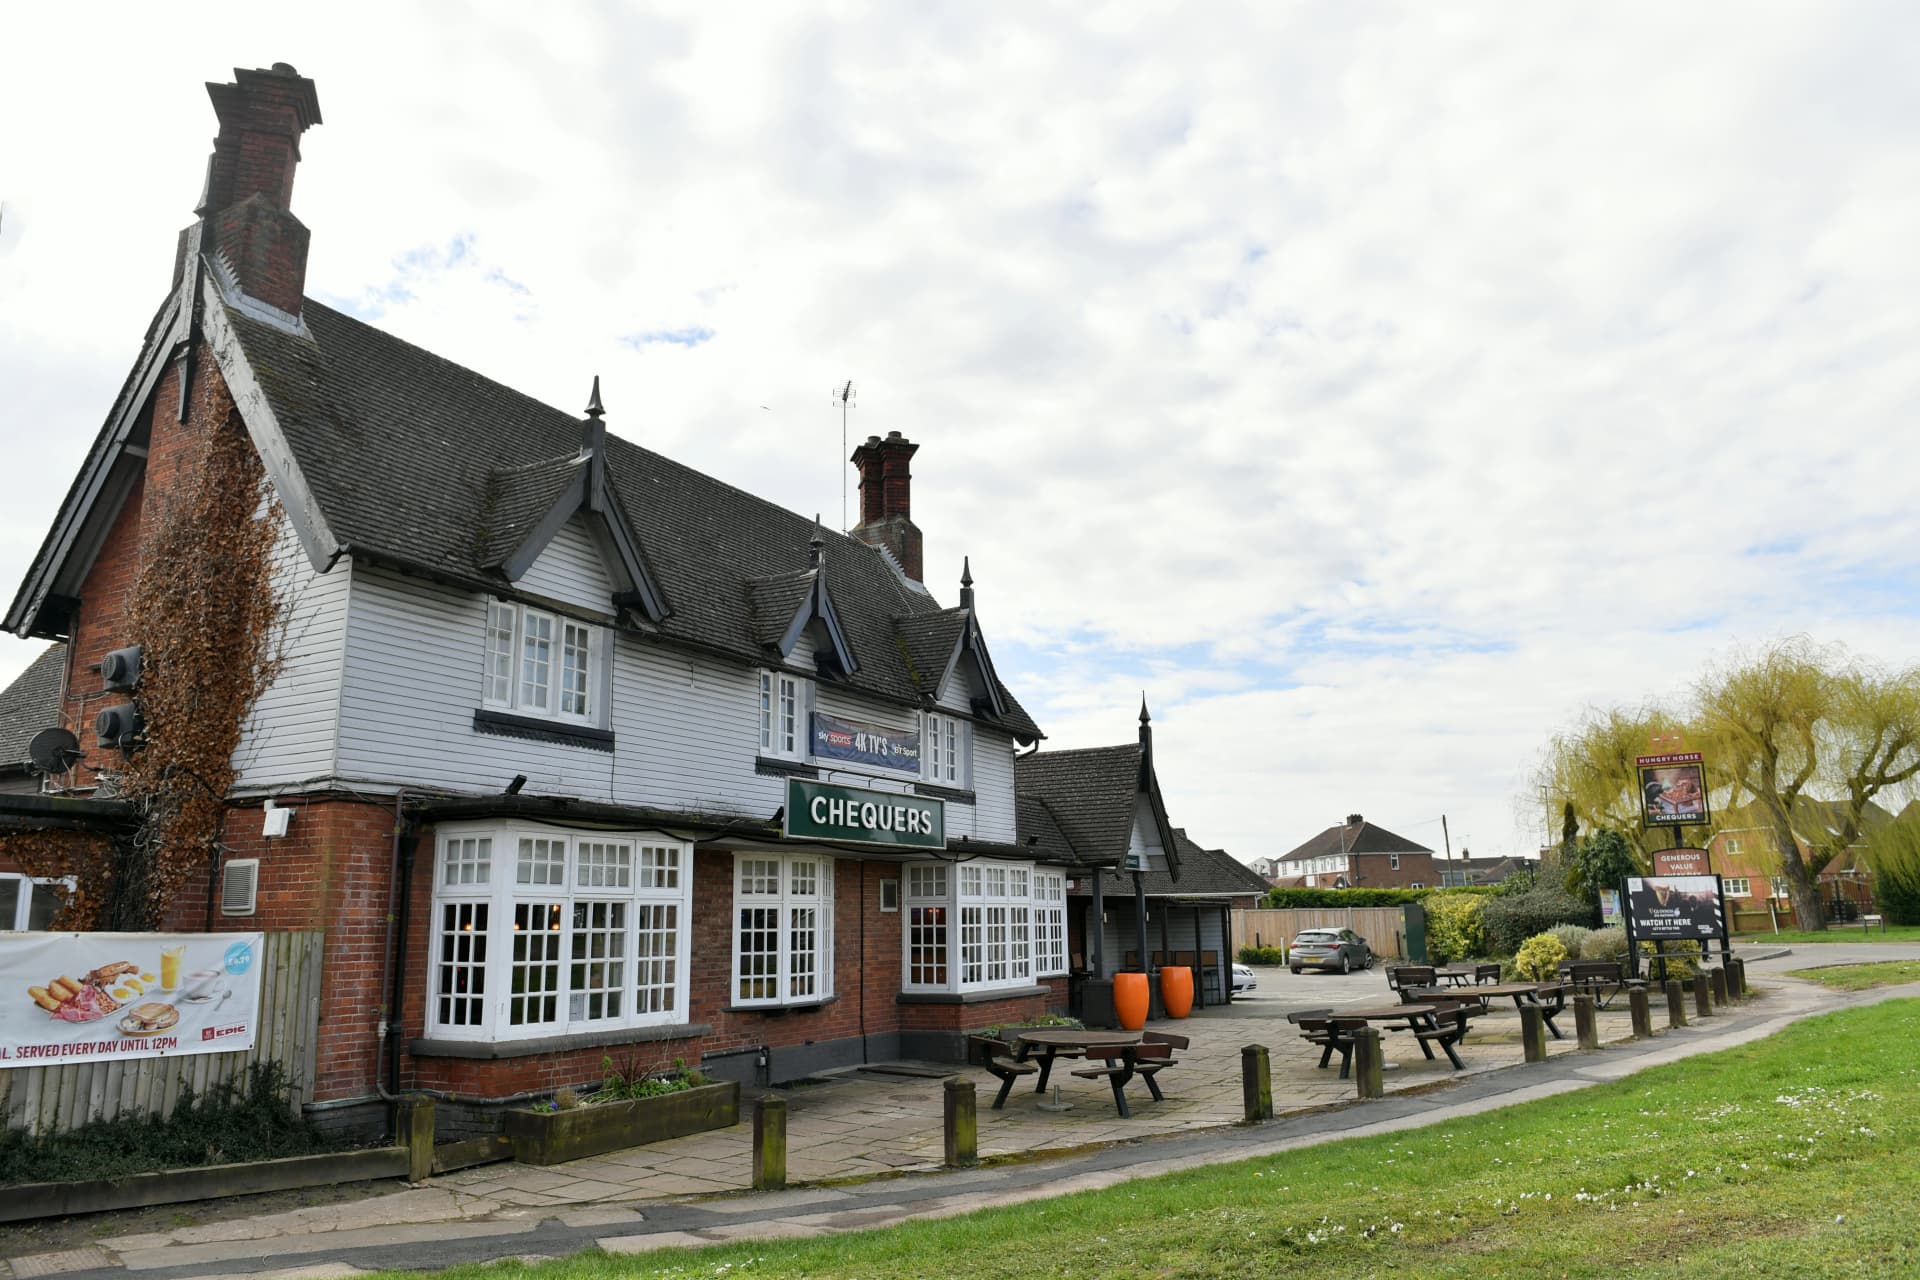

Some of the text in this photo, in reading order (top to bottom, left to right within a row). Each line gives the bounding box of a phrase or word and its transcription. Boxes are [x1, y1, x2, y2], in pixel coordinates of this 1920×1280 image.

[818, 731, 851, 745] sky sports
[855, 732, 888, 756] 4K TV'S
[1639, 756, 1671, 764] HUNGRY
[811, 796, 932, 835] CHEQUERS
[1656, 813, 1697, 821] CHEQUERS
[1660, 854, 1701, 862] GENEROUS
[1639, 919, 1664, 927] WATCH
[1673, 918, 1691, 926] HERE
[0, 1037, 177, 1060] L. SERVED EVERY DAY UNTIL 12PM
